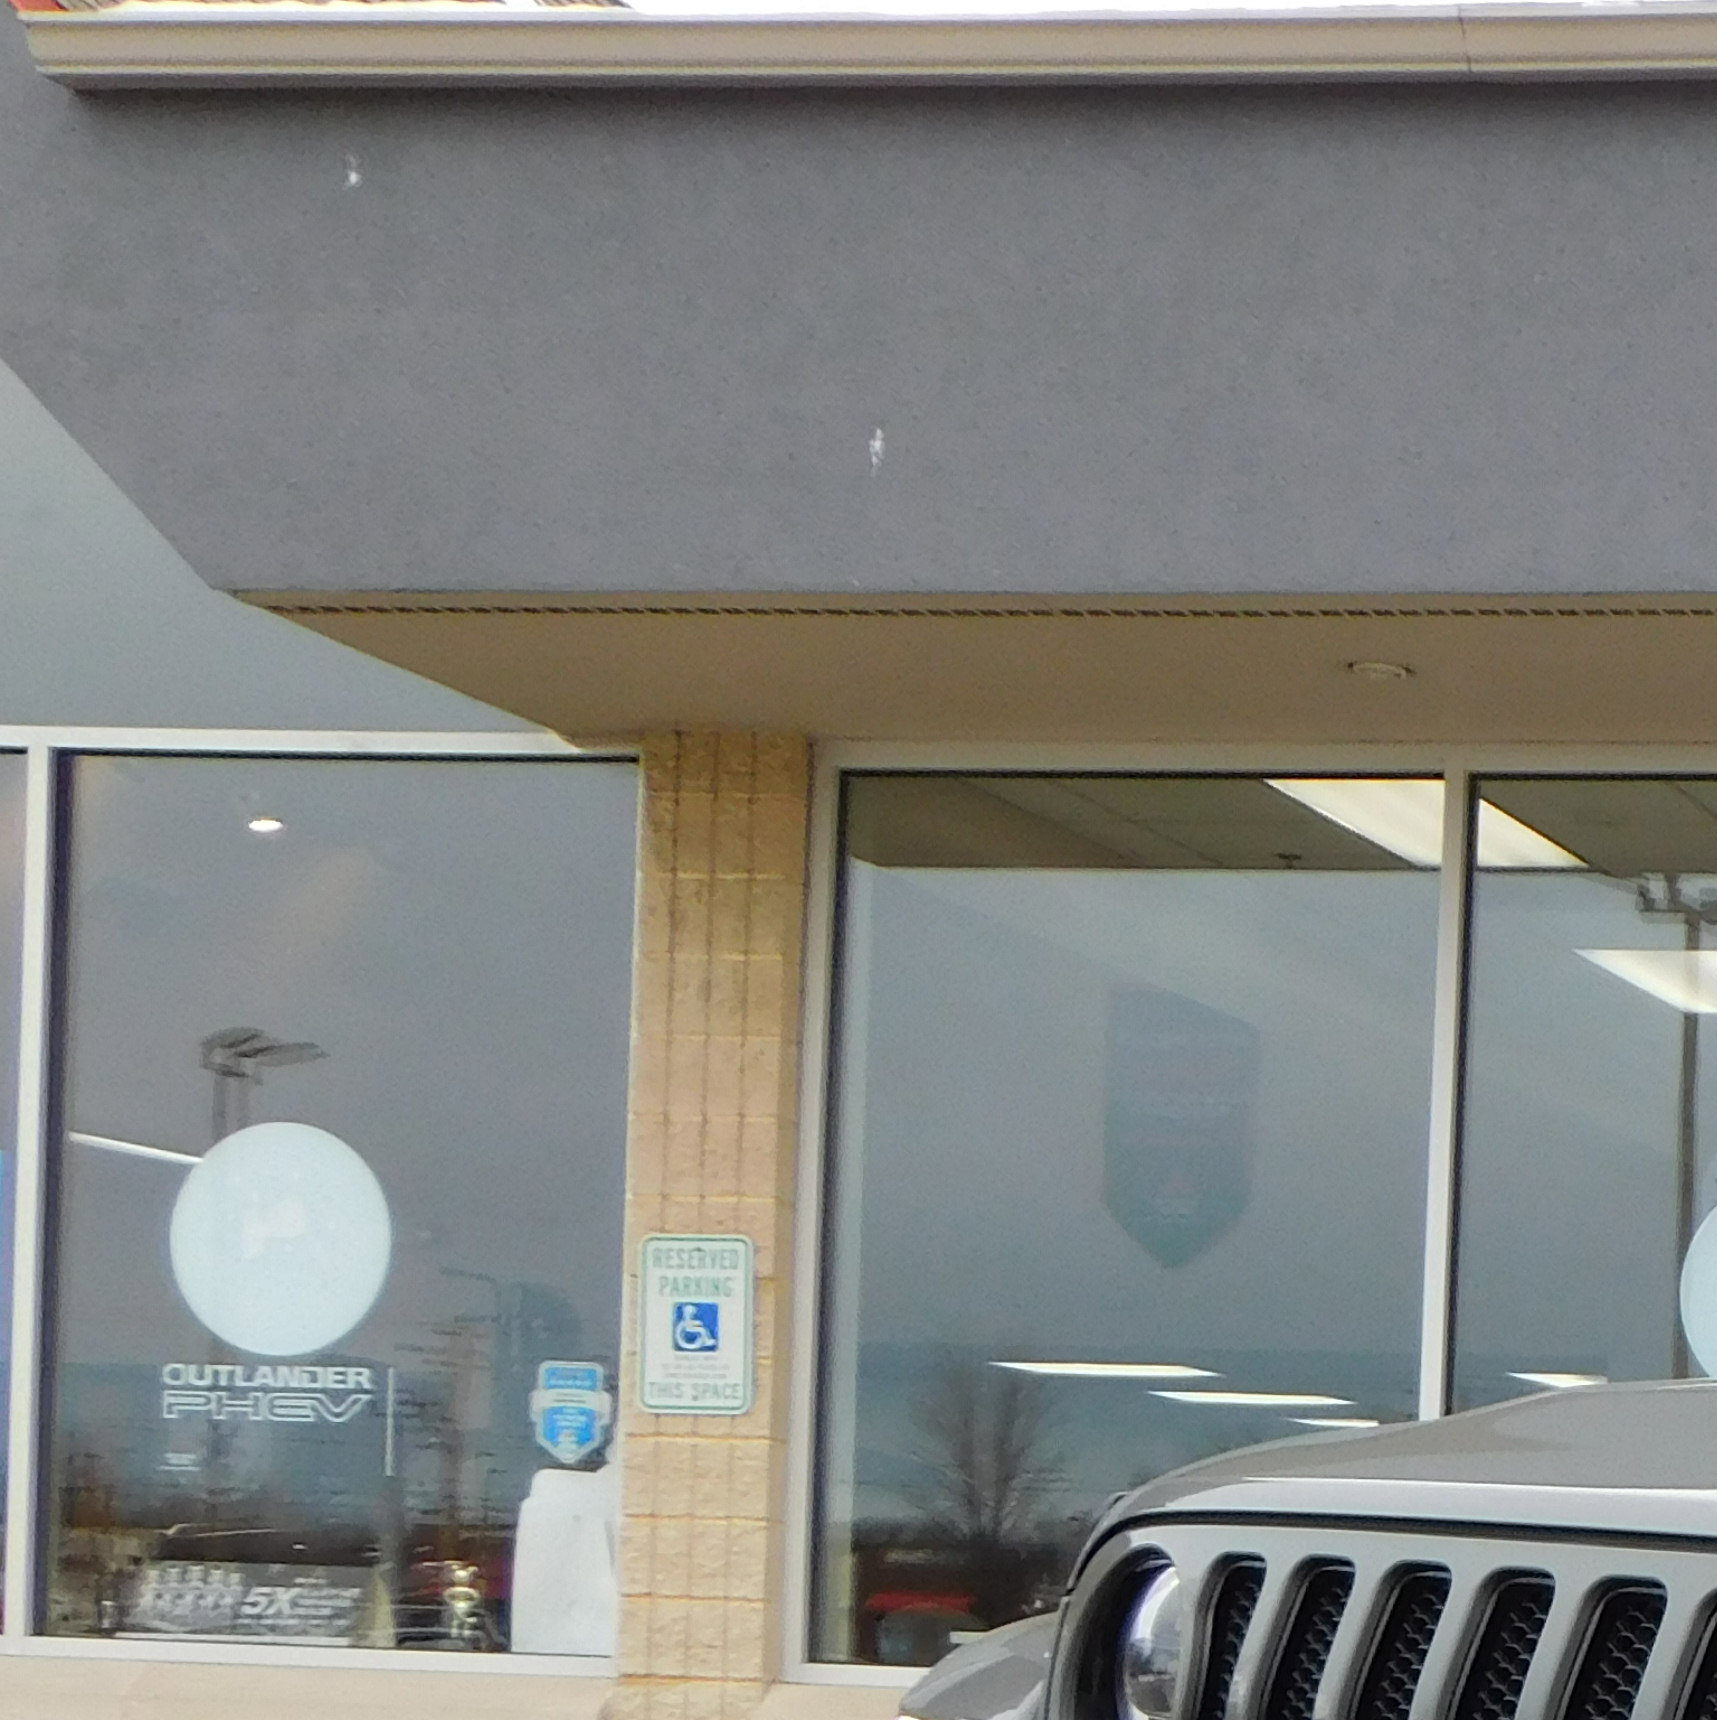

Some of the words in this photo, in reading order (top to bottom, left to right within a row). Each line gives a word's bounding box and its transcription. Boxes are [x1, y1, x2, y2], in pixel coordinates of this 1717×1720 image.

[652, 1248, 739, 1270] RESERVED
[658, 1276, 733, 1298] PARKING
[161, 1362, 374, 1389] OUTLANDER
[648, 1382, 685, 1399] THIS
[691, 1382, 741, 1400] SPACE
[161, 1390, 373, 1422] PHEV
